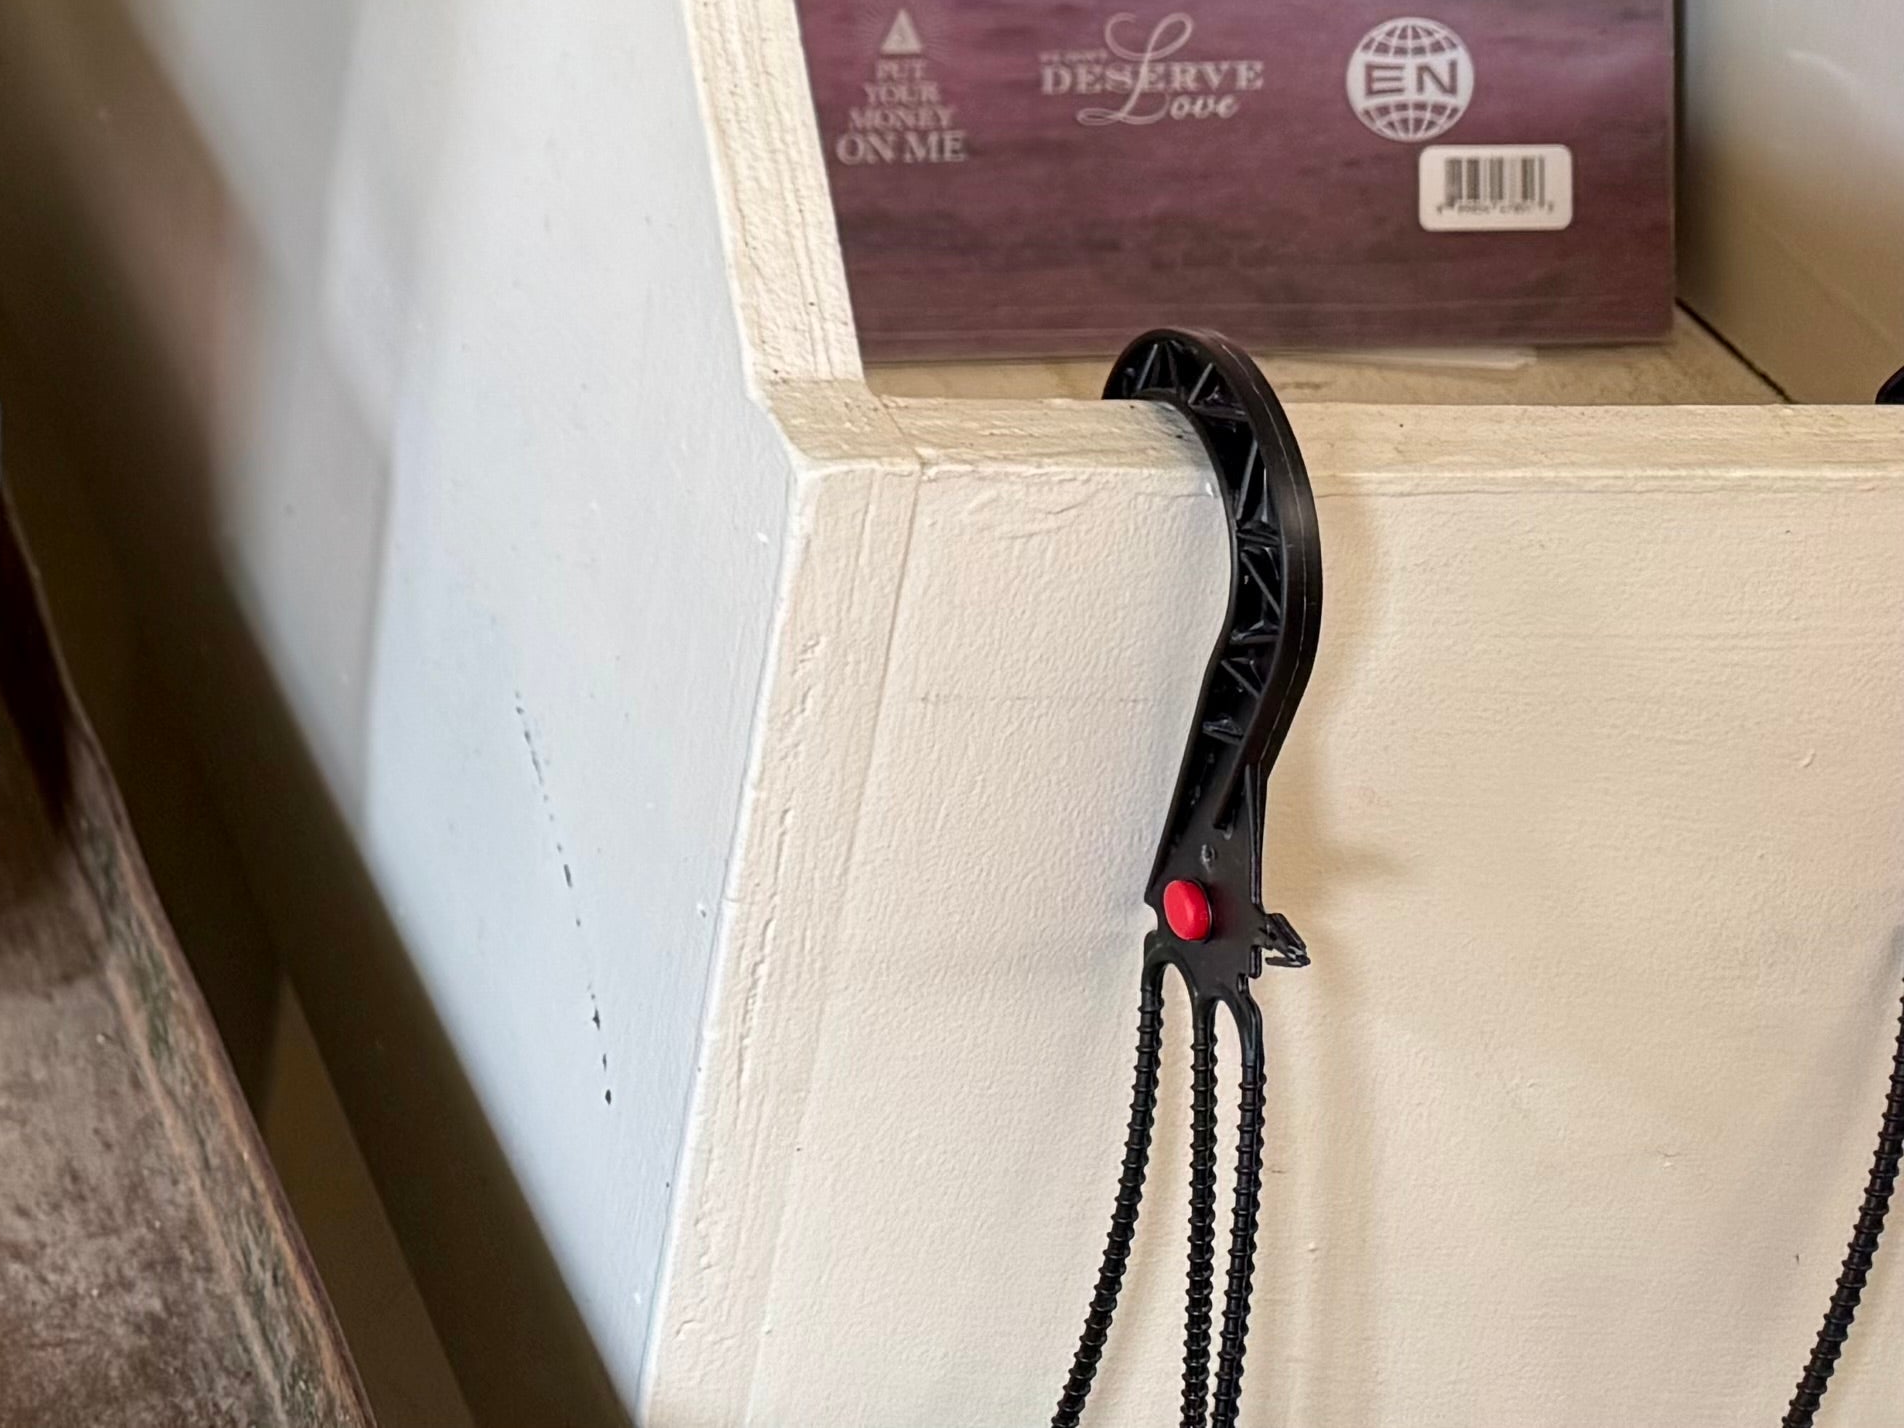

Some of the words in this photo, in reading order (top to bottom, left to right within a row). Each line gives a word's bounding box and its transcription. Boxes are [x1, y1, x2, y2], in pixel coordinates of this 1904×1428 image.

[1042, 61, 1265, 94] DESERVE
[1076, 12, 1240, 126] Love
[1364, 60, 1457, 96] EN
[836, 131, 896, 165] ON
[903, 130, 966, 163] ME
